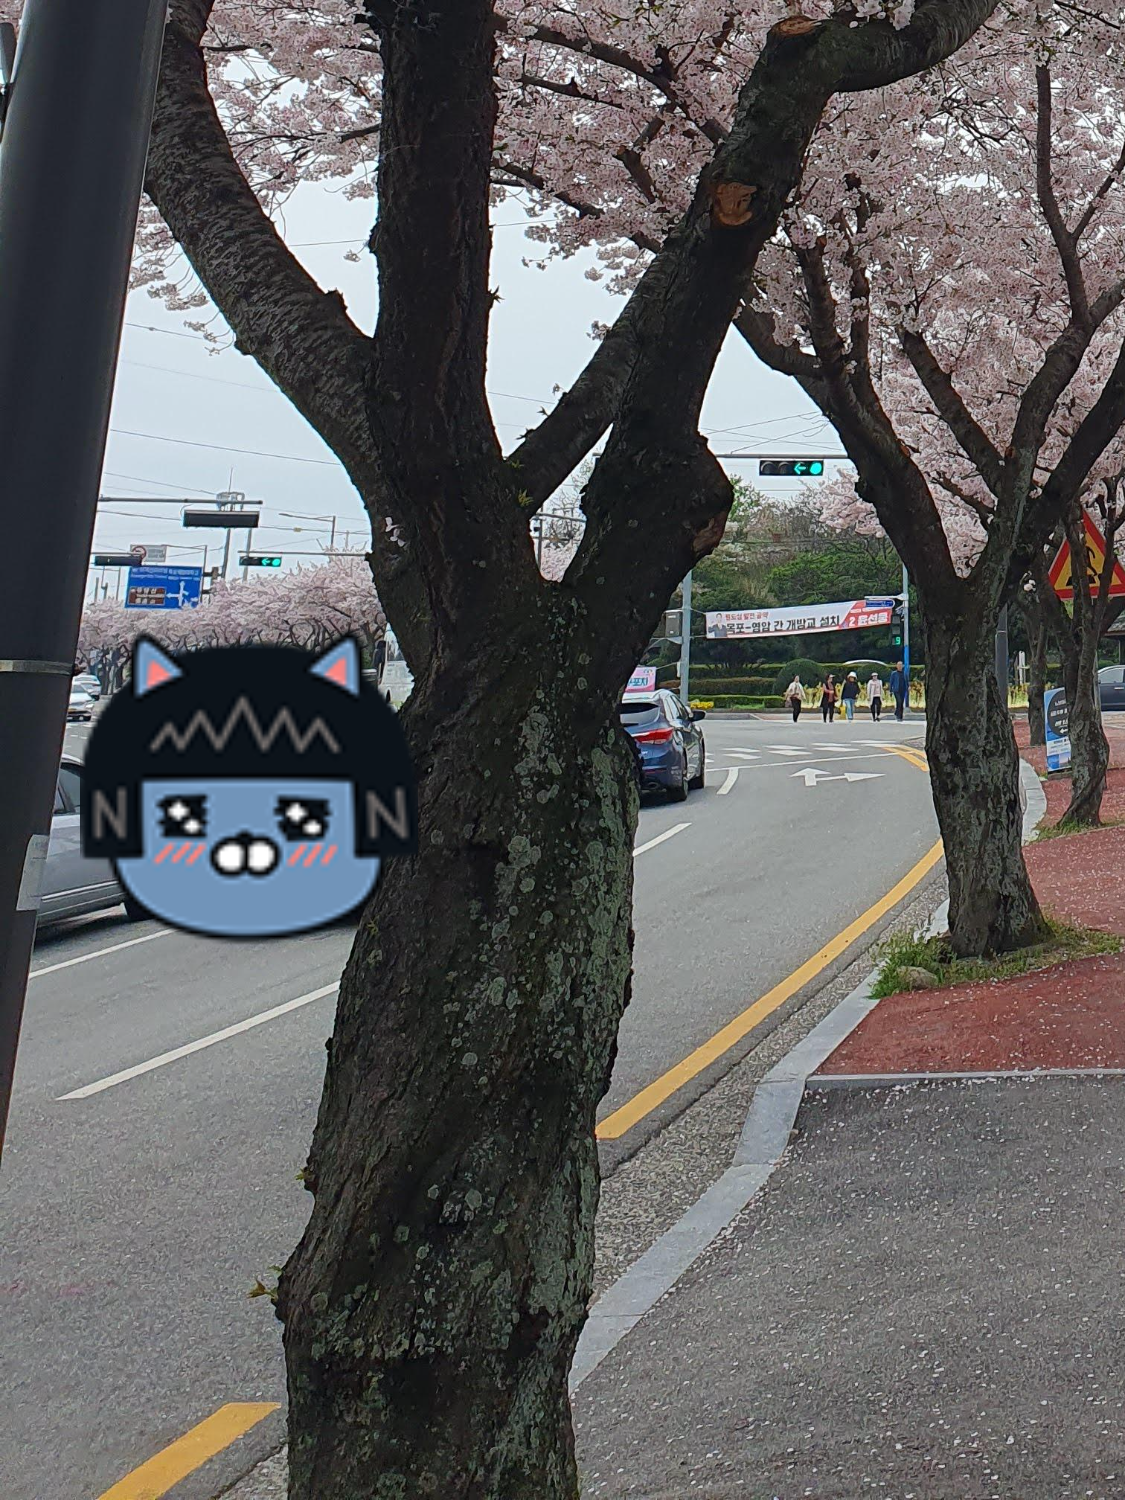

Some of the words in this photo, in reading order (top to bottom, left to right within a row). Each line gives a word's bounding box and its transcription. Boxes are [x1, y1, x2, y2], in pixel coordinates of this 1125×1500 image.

[726, 621, 771, 635] 목포-영암
[820, 615, 839, 628] 설치
[849, 616, 856, 627] 2
